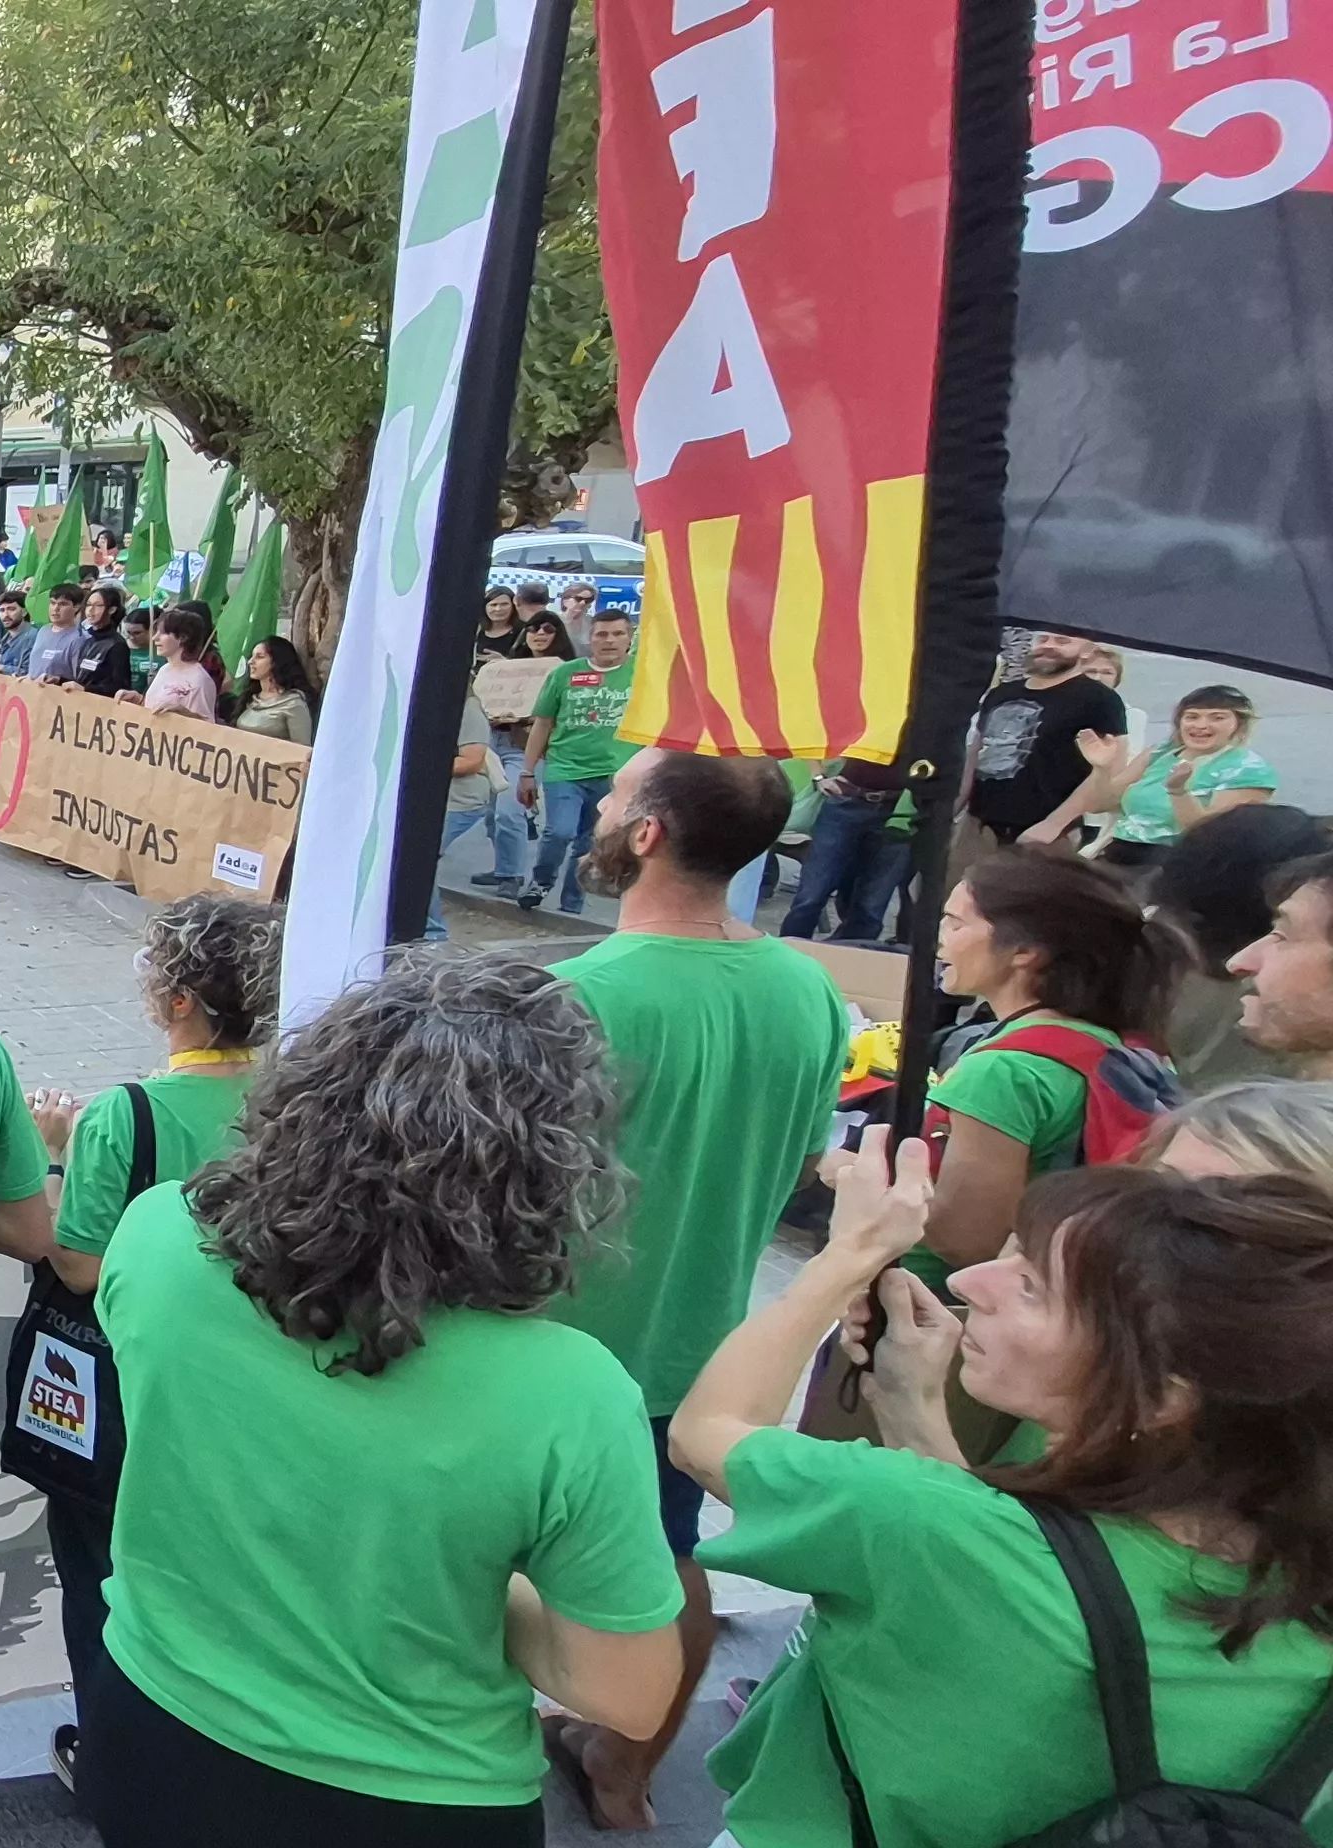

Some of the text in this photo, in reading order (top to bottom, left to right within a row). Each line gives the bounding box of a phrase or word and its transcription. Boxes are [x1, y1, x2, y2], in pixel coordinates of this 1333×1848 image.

[606, 601, 642, 615] POL
[49, 705, 66, 744] A
[74, 712, 116, 756] LAS
[120, 722, 302, 810] SANCIONES
[51, 788, 179, 865] INJUSTAS
[33, 1381, 79, 1419] STEA
[24, 1413, 86, 1448] INTERSINDICAL
